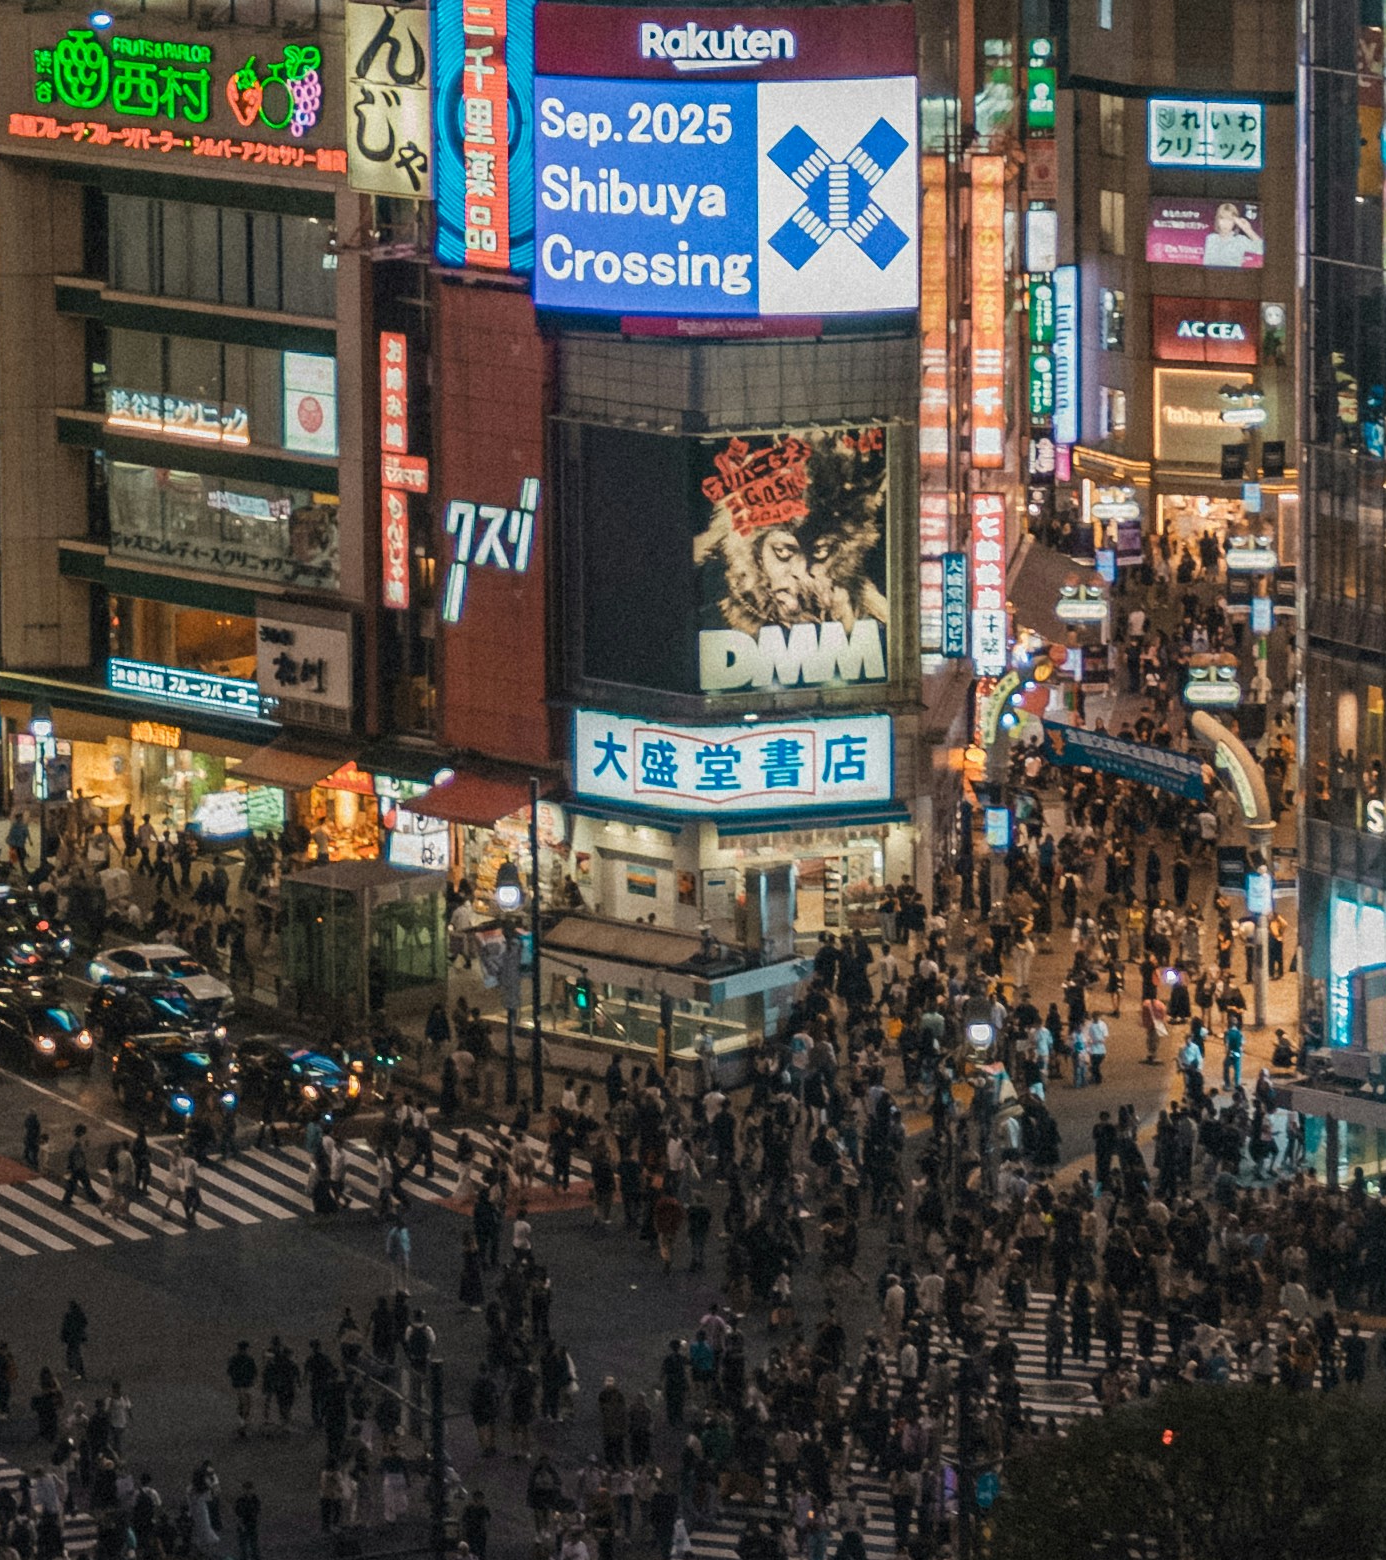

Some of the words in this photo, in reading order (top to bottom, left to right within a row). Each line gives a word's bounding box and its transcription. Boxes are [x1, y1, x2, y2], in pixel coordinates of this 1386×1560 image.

[641, 22, 795, 63] Rakuten
[113, 61, 211, 123] 西村
[1181, 110, 1258, 129] れいわ
[628, 103, 732, 144] 2025
[1157, 137, 1257, 161] クリニック
[541, 165, 727, 225] Shibuya
[542, 234, 753, 296] Crossing
[677, 319, 715, 334] Rakuten
[443, 478, 540, 623] クスリ
[699, 619, 886, 691] DMM
[594, 732, 869, 792] 大盛堂書店
